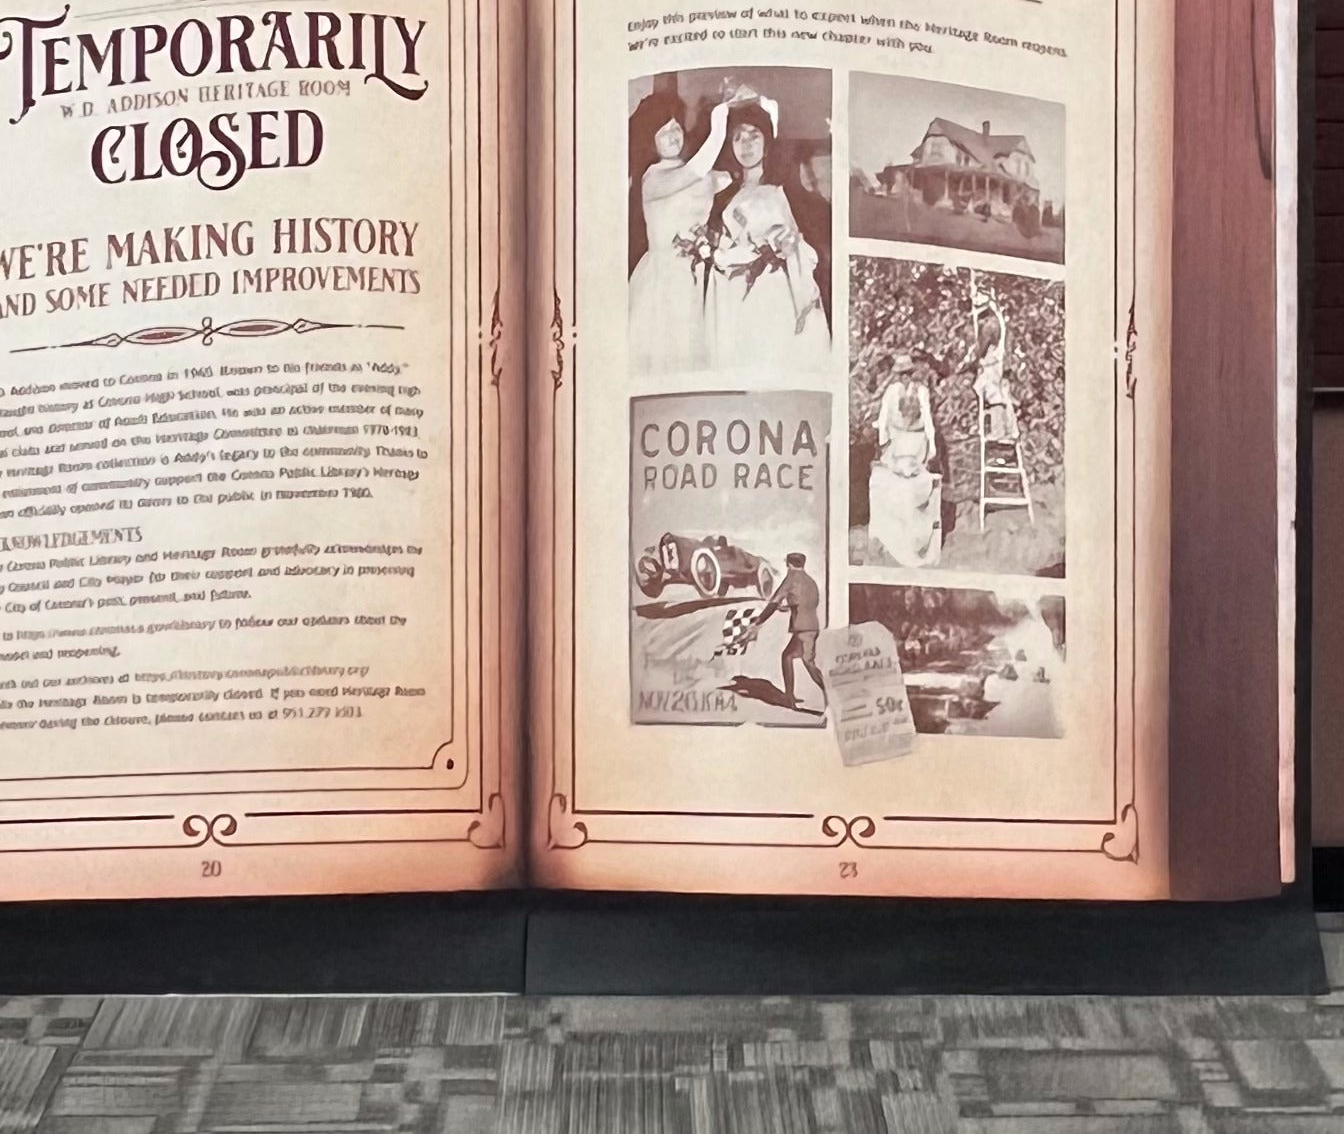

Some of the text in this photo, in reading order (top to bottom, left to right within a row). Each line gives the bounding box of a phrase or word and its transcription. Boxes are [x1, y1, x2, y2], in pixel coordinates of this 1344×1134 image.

[108, 88, 188, 114] ADDISON
[199, 80, 290, 102] HERITAGE
[300, 80, 350, 97] ROOM
[91, 109, 324, 191] CLOSED
[106, 221, 255, 270] MAKING
[273, 218, 419, 257] HISTORY
[45, 285, 110, 314] SOME
[122, 274, 220, 302] NEEDED
[231, 268, 420, 295] IMPROVEMENTS
[311, 382, 324, 395] of
[640, 419, 818, 458] CORONA
[643, 464, 814, 492] ROAD RACE
[217, 490, 255, 505] public
[343, 563, 355, 575] in
[29, 599, 41, 612] of
[202, 860, 221, 878] 20
